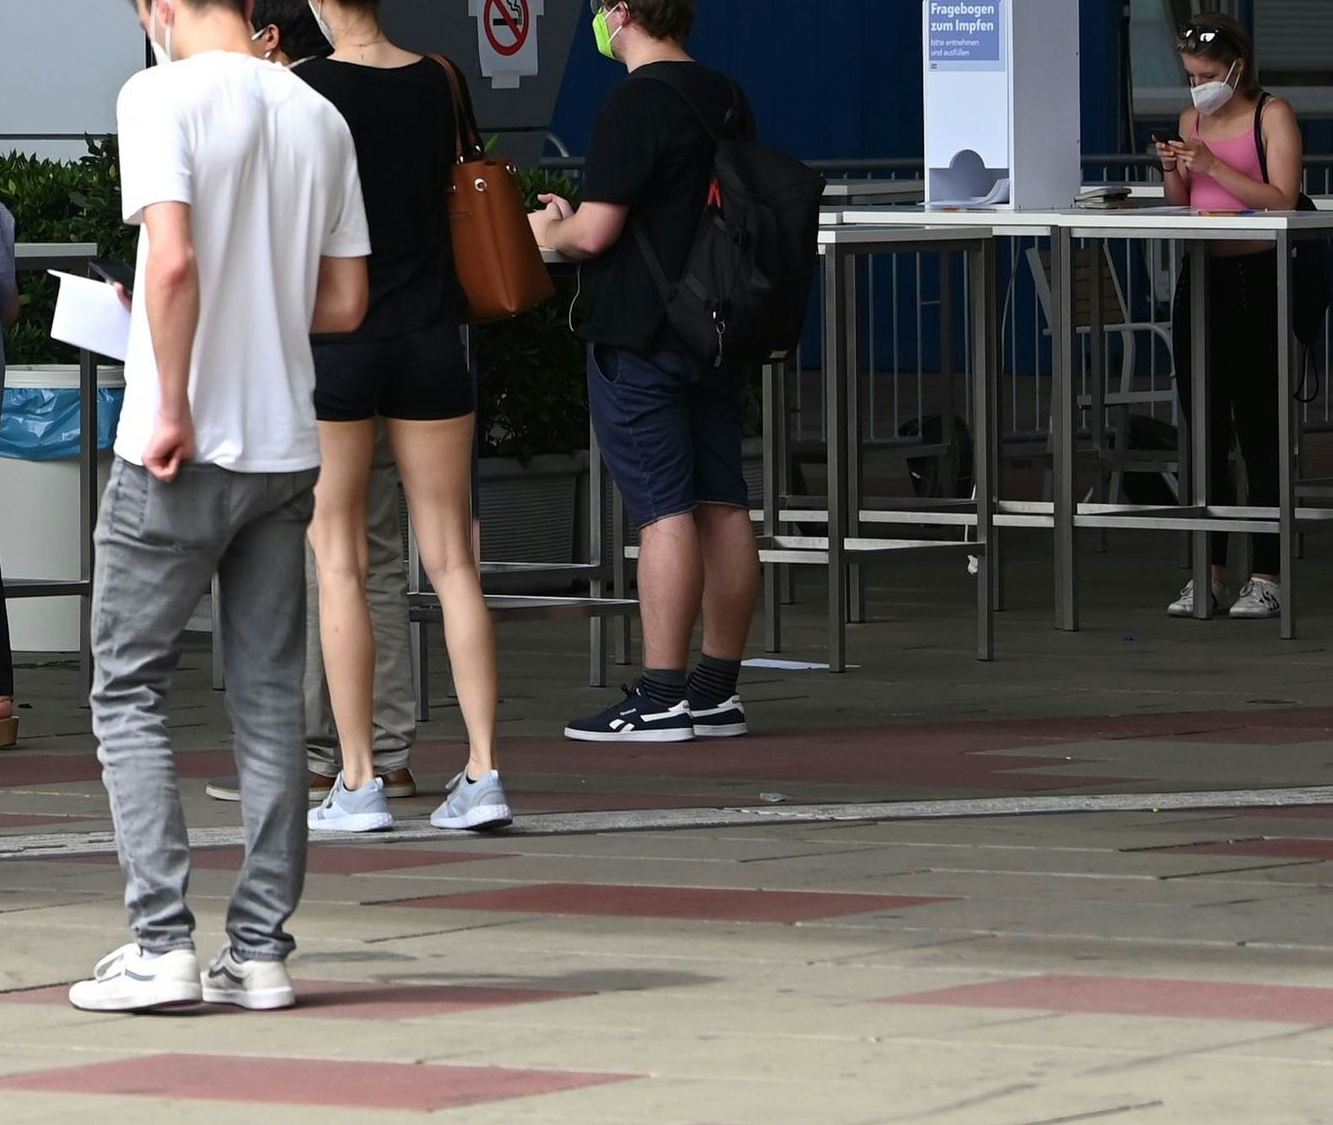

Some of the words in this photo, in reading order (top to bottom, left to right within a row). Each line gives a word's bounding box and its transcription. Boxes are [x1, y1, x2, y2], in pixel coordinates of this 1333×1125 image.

[930, 2, 995, 18] Fragebogen
[931, 22, 953, 31] zum
[955, 18, 994, 34] Impfen
